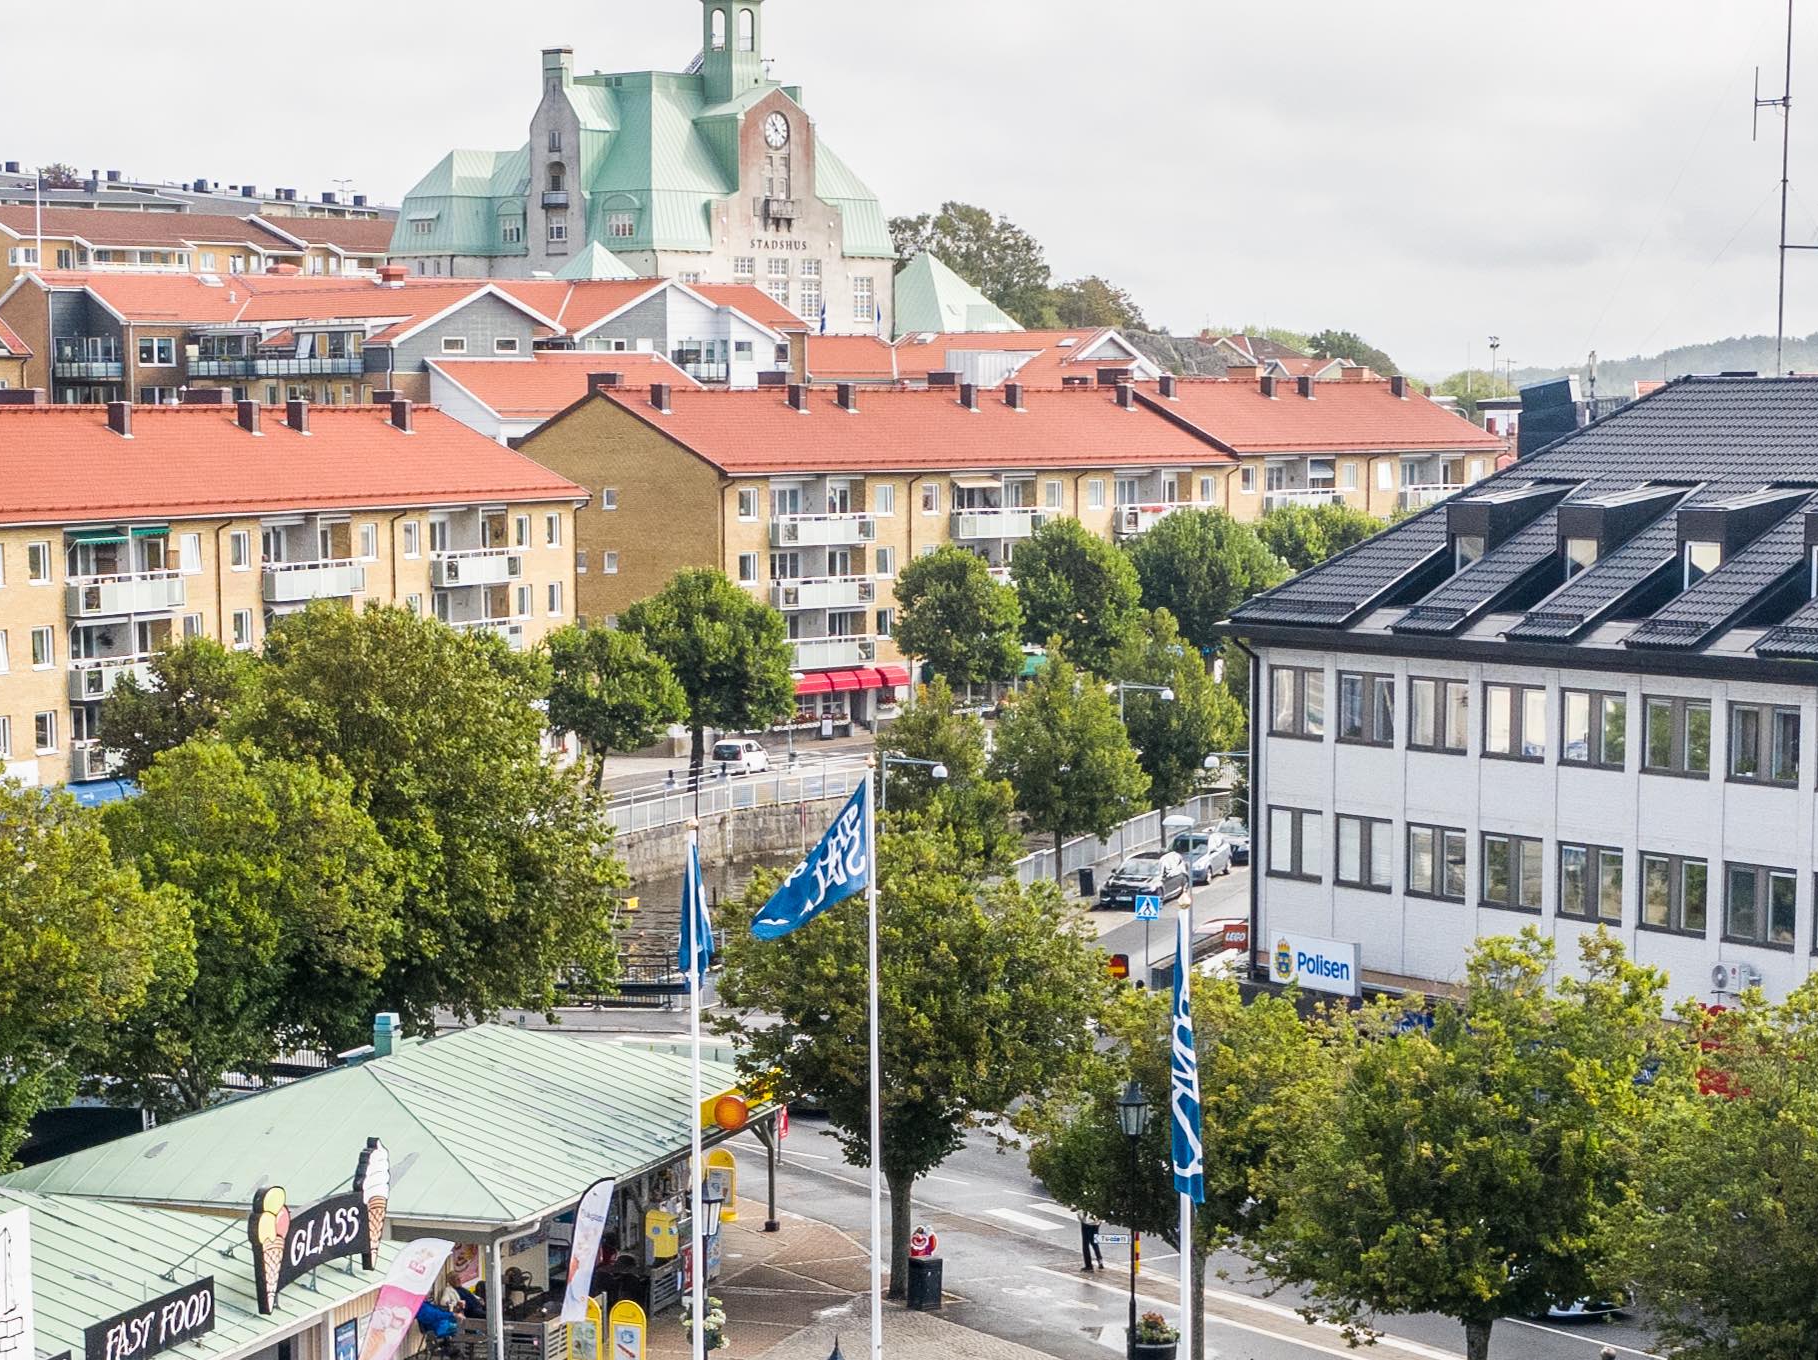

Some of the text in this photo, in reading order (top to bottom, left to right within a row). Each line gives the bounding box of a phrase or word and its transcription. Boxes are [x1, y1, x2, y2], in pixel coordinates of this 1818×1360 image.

[750, 239, 807, 250] STADSHUS
[1225, 932, 1247, 942] LEGO
[1297, 951, 1350, 981] Polisen
[290, 1206, 360, 1267] GLASS
[159, 1288, 213, 1341] FOOD
